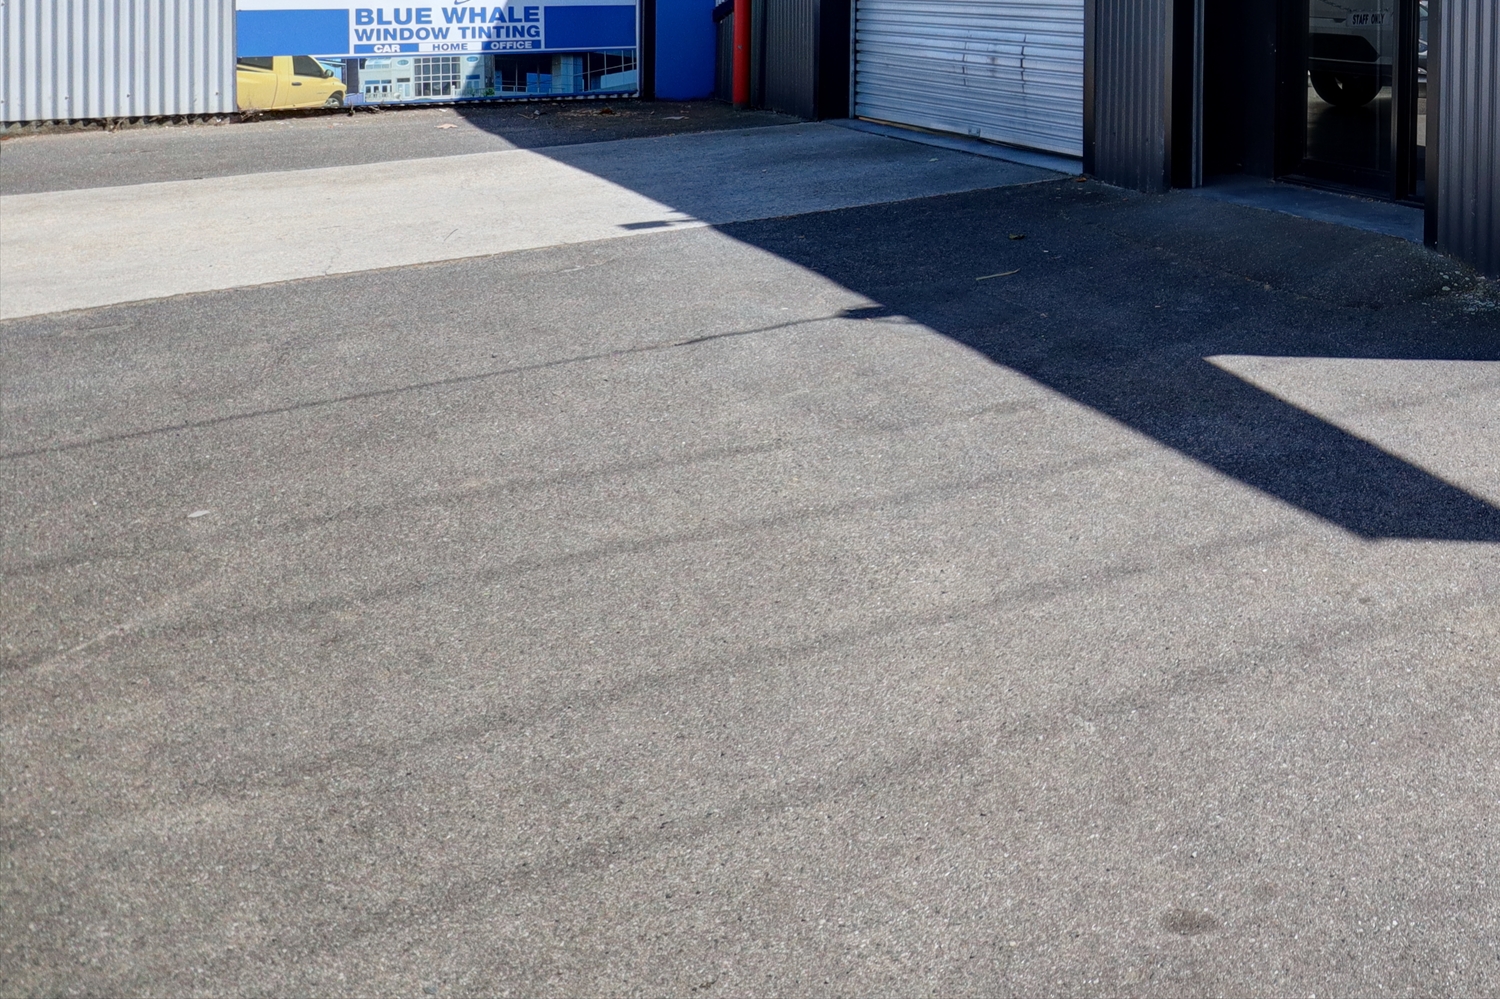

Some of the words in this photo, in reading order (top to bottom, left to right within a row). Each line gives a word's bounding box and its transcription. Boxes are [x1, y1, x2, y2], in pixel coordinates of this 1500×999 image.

[355, 7, 432, 26] BLUE
[441, 6, 540, 24] WHALE
[1352, 13, 1369, 25] STAFF
[1371, 13, 1385, 24] ONLY
[354, 27, 450, 42] WINDOW
[457, 25, 540, 39] TINTING
[373, 44, 400, 53] CAR
[432, 43, 468, 51] HOME
[490, 41, 532, 49] OFFICE
